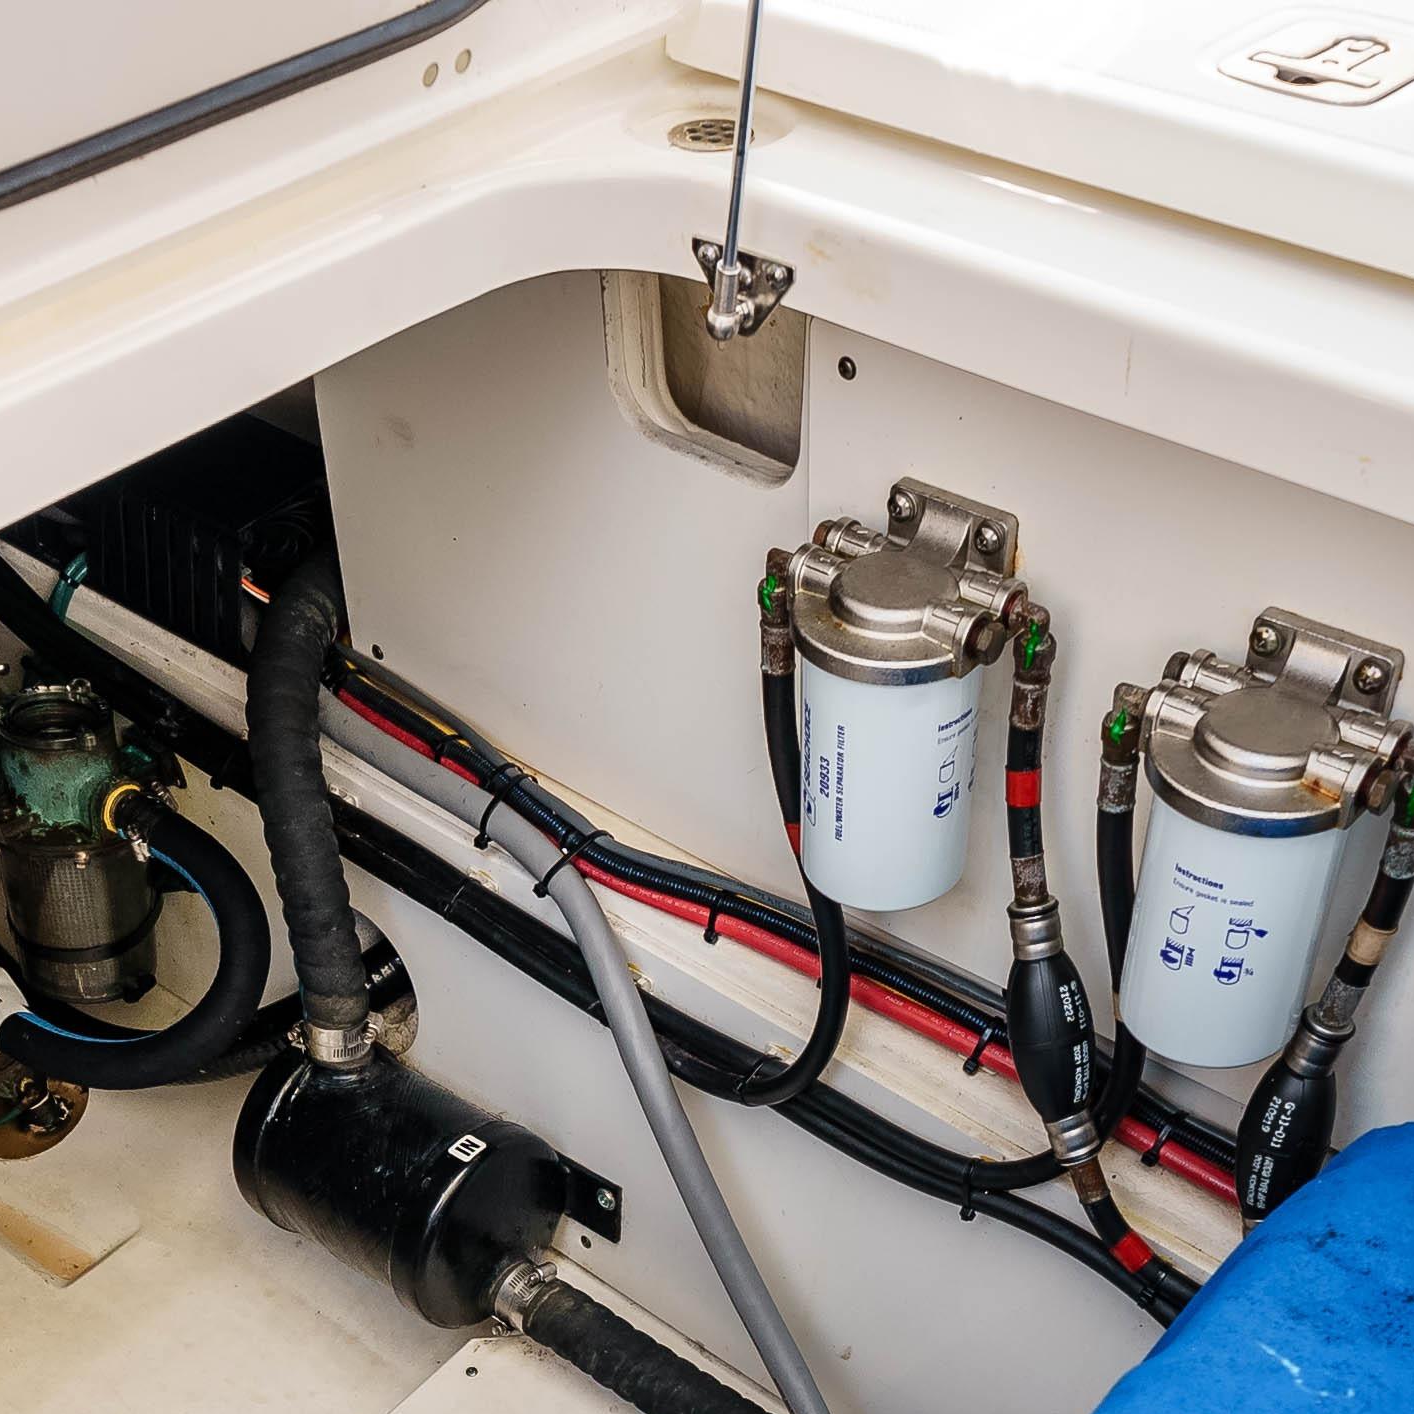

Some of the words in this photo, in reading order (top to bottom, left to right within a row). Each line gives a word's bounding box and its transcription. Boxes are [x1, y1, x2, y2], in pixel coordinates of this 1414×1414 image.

[837, 724, 846, 750] FILTER
[819, 755, 830, 799] 20933
[836, 750, 845, 796] SEPARATOR
[834, 796, 844, 842] FUEL/WATER
[1174, 862, 1224, 890] Instructions
[1059, 984, 1076, 1022] 210222
[1261, 1095, 1282, 1133] 210219
[1270, 1101, 1296, 1148] G-11-011
[454, 1138, 480, 1156] IN
